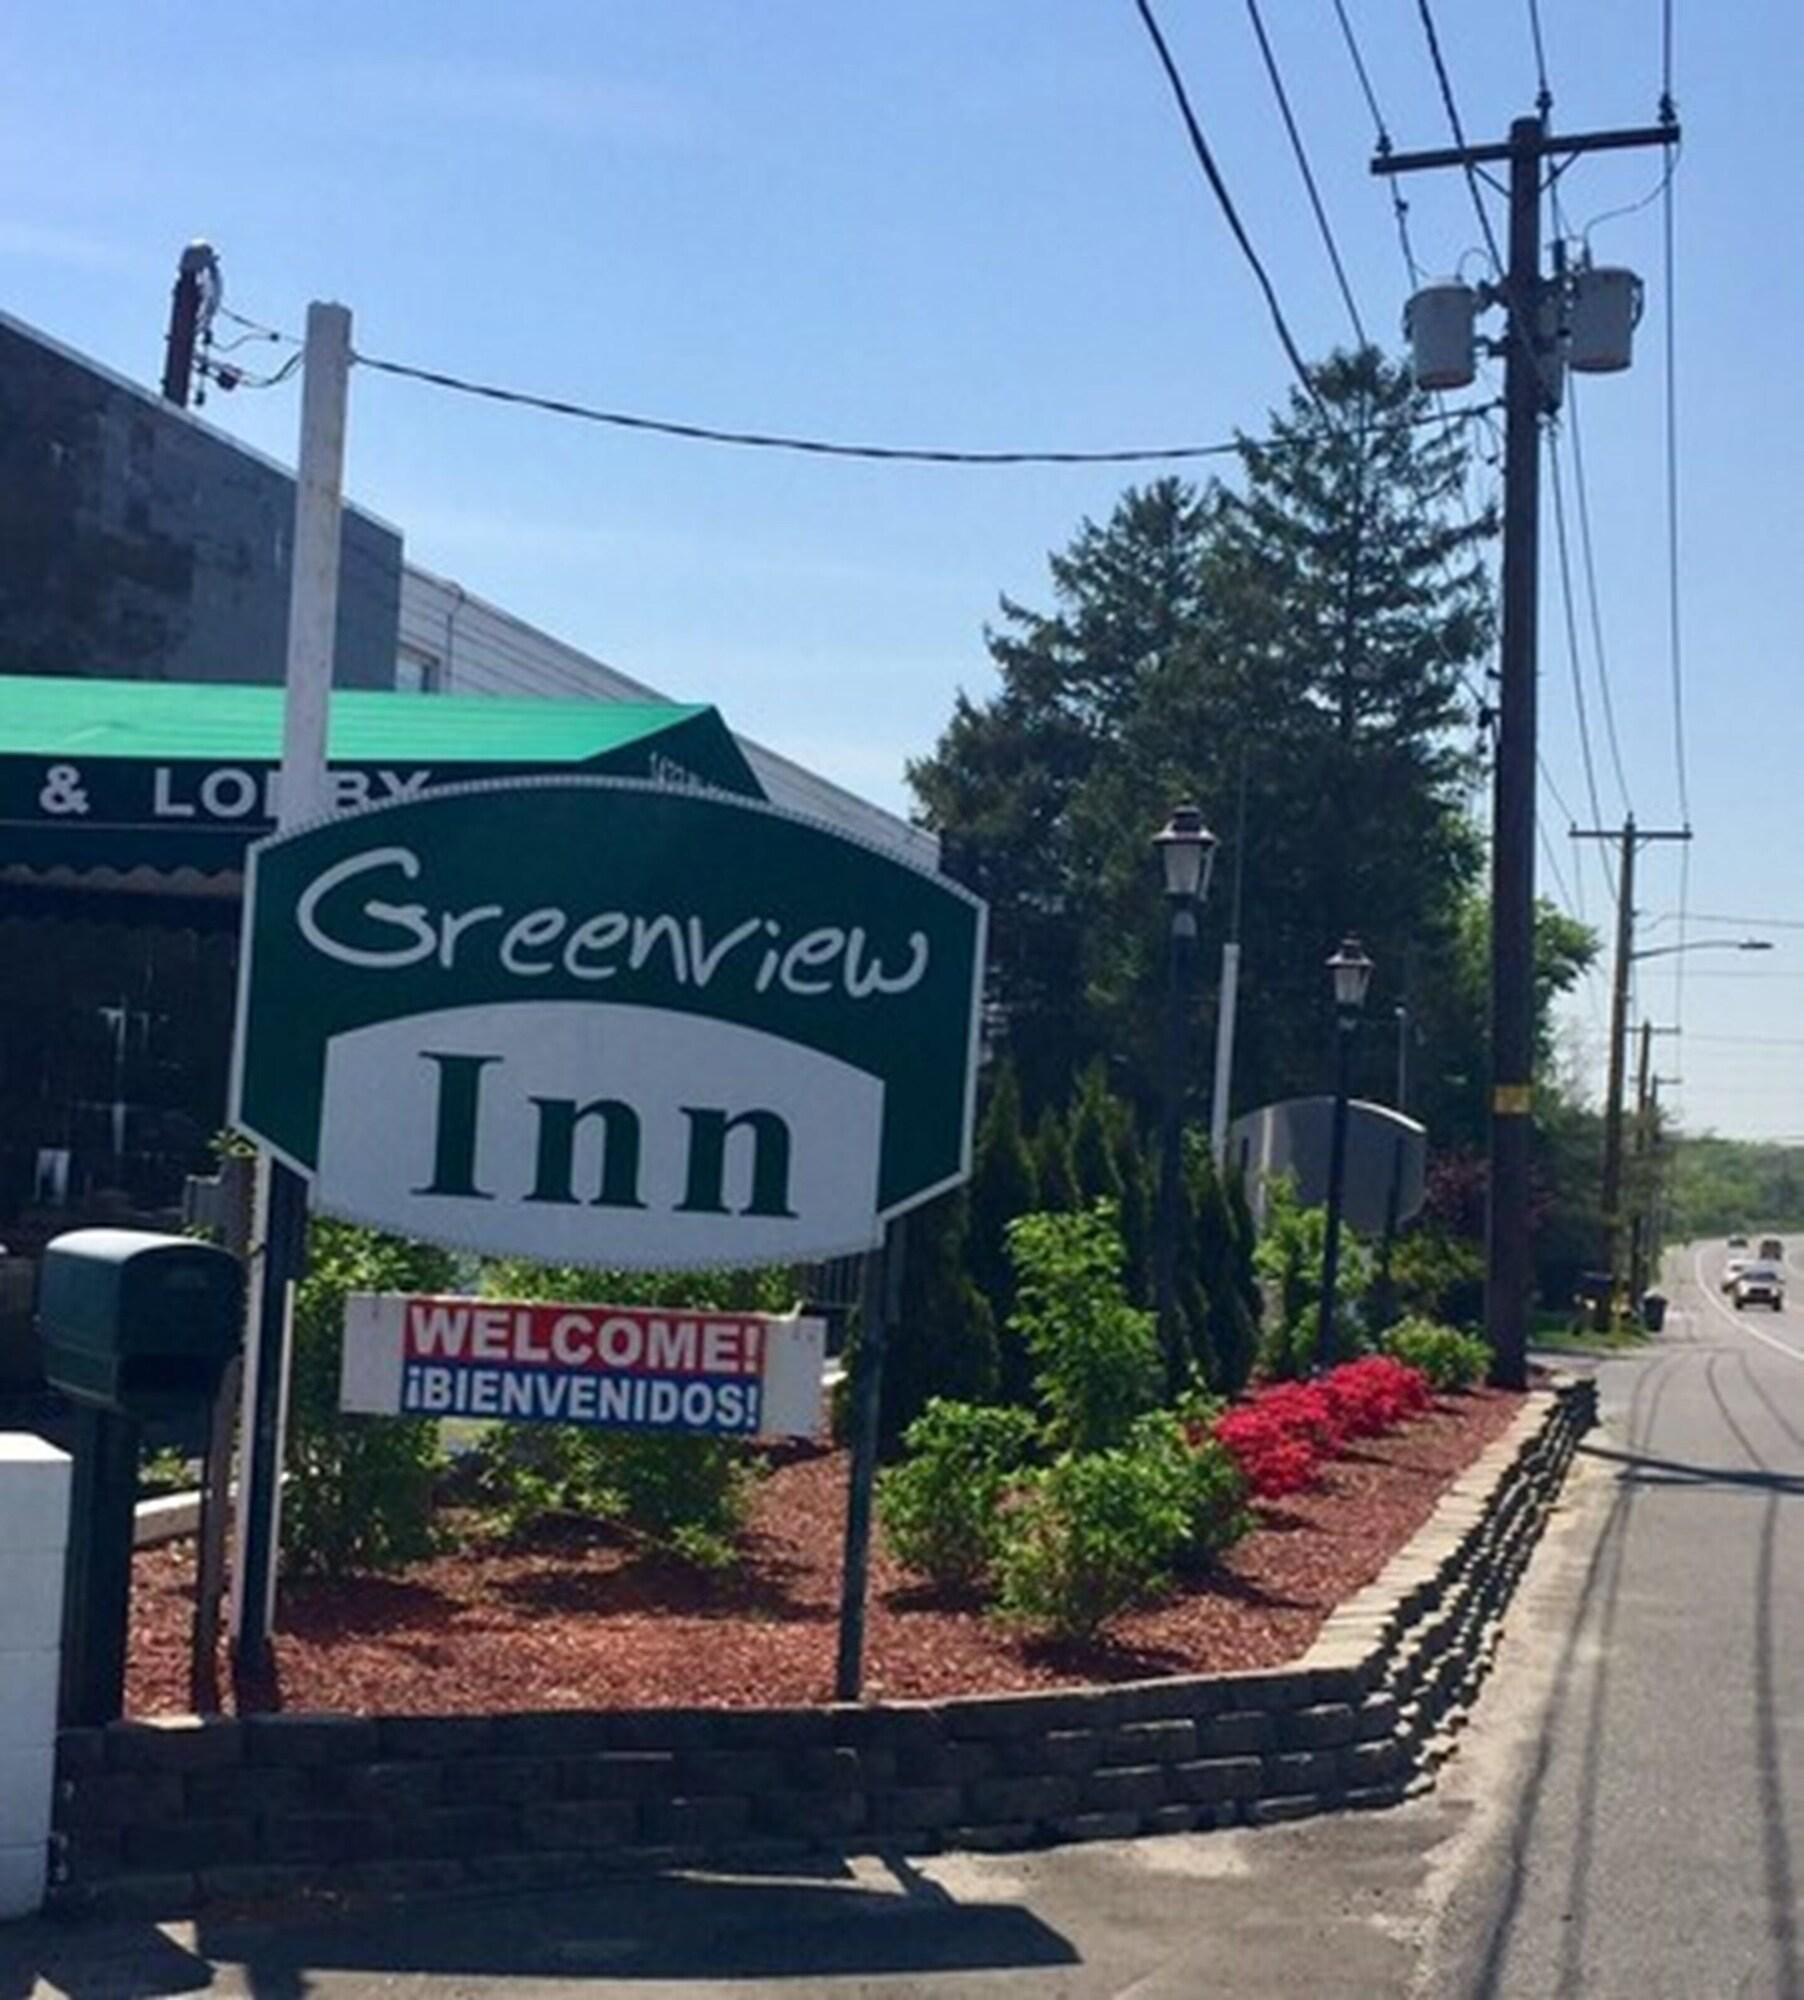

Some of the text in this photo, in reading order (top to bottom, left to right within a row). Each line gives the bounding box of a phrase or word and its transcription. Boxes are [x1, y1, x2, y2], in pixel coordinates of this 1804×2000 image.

[39, 764, 430, 818] & LOBY
[296, 846, 929, 998] Greenview
[409, 1051, 799, 1218] Inn
[410, 1305, 761, 1374] WELCOME!
[406, 1366, 759, 1427] ¡BIENVENIDOS!
